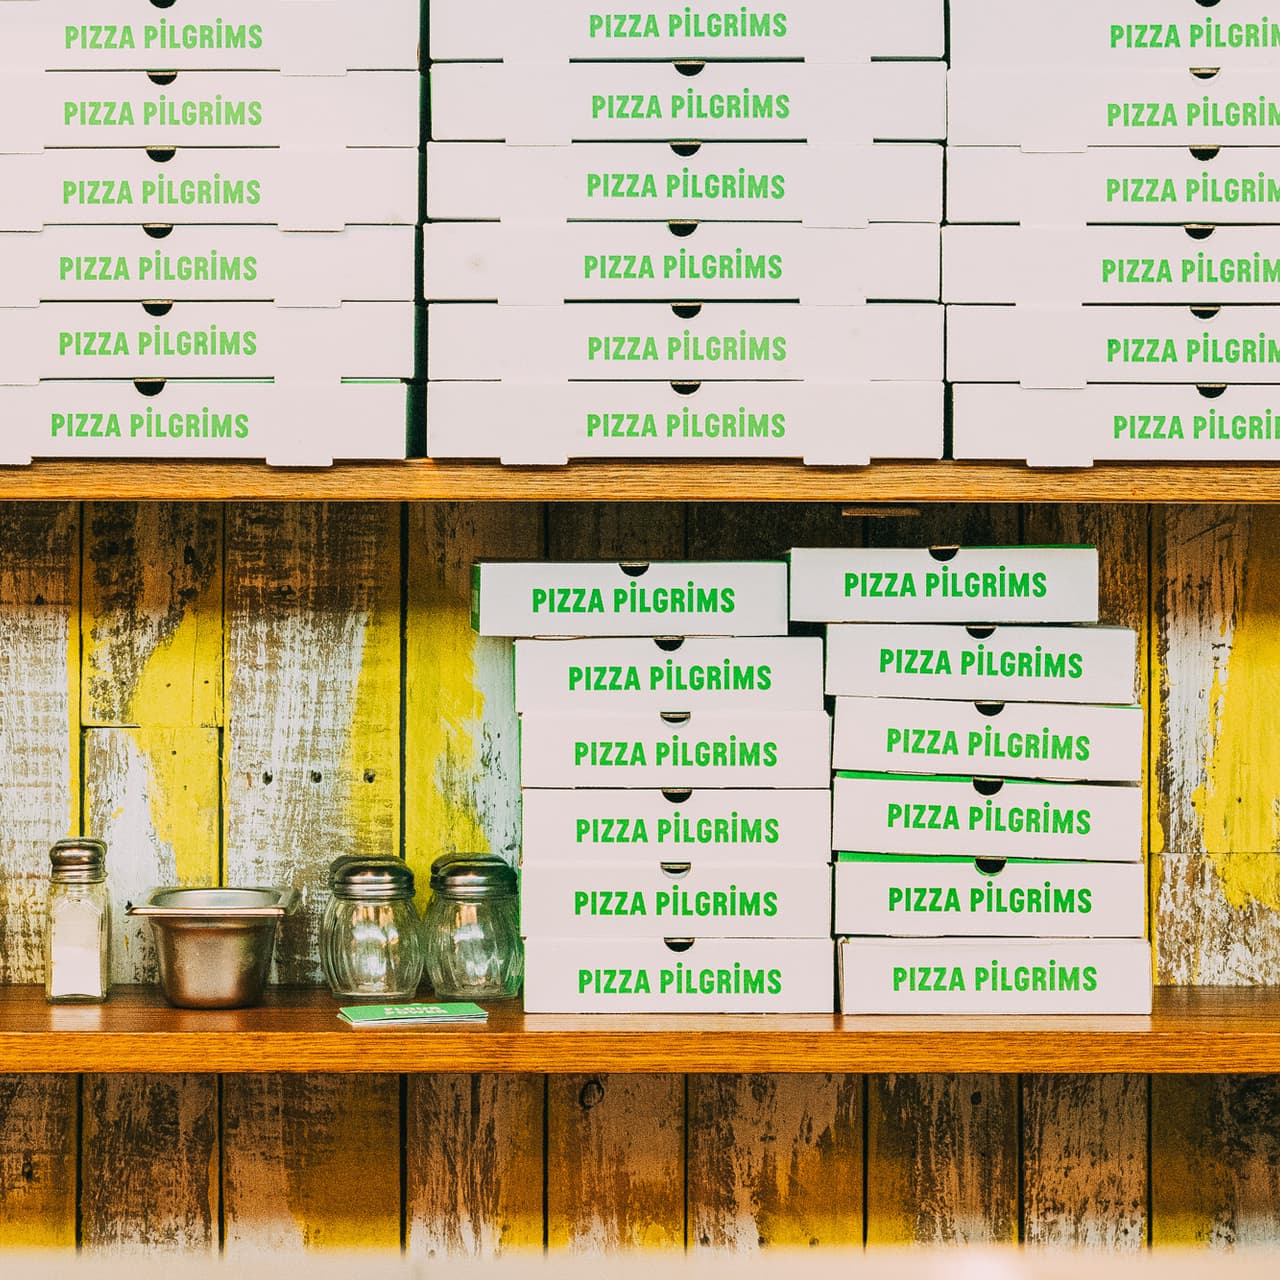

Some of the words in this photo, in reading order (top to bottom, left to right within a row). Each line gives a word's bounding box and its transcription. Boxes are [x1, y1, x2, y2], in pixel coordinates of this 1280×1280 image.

[66, 26, 134, 48] PIZZA
[589, 14, 659, 38] PIZZA
[592, 95, 662, 119] PIZZA
[1107, 103, 1178, 127] PIZZA
[64, 181, 132, 204] PIZZA
[587, 173, 657, 198] PIZZA
[60, 257, 129, 280] PIZZA
[1102, 259, 1172, 283] PIZZA
[588, 336, 658, 360] PIZZA
[1107, 338, 1178, 363] PIZZA
[51, 413, 120, 437] PIZZA
[587, 414, 657, 437] PIZZA
[1114, 416, 1184, 439] PIZZA
[844, 572, 917, 598] PIZZA
[532, 587, 605, 613] PIZZA
[880, 648, 952, 675] PIZZA
[569, 666, 640, 691] PIZZA
[575, 741, 646, 766] PIZZA
[887, 728, 959, 755] PIZZA
[887, 803, 960, 830] PIZZA
[576, 818, 648, 843] PIZZA
[575, 891, 647, 916] PIZZA
[889, 887, 961, 912] PIZZA
[578, 969, 650, 994] PIZZA
[893, 966, 965, 992] PIZZA
